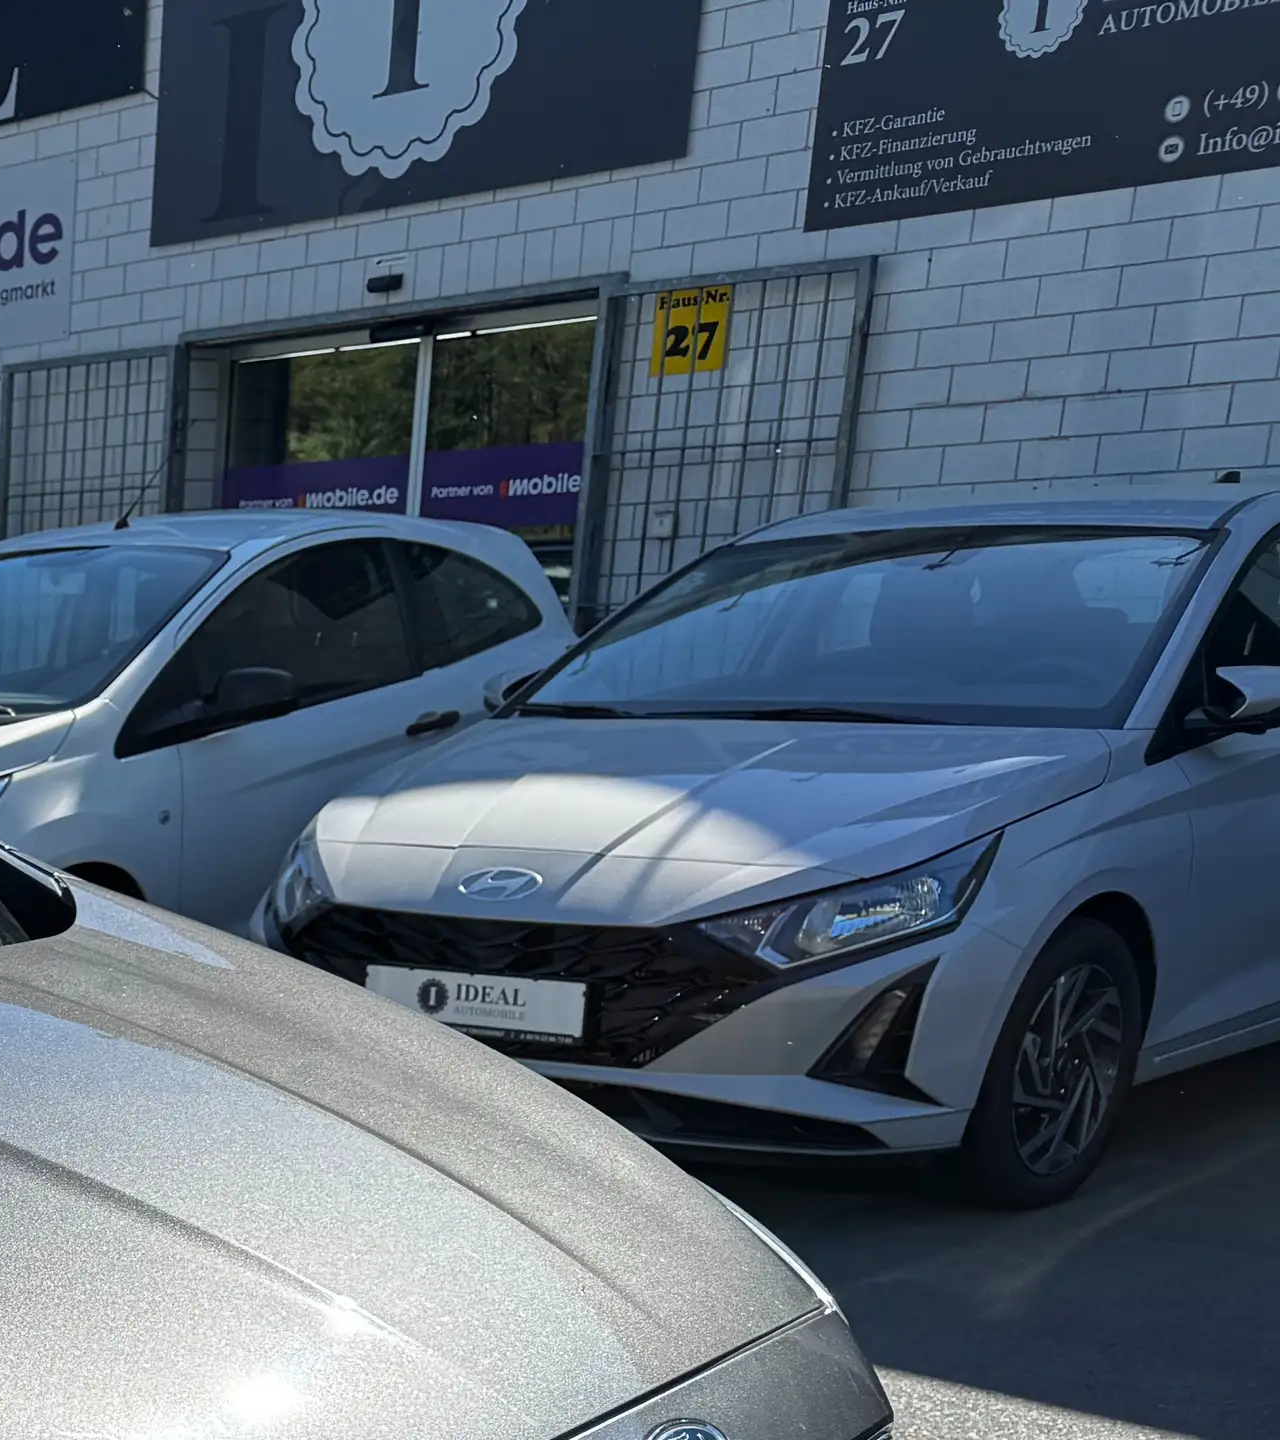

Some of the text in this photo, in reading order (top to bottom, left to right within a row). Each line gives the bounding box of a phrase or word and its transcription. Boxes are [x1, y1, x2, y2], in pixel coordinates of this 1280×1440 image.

[1098, 0, 1280, 35] AUTOMOB
[840, 9, 906, 66] 27
[1203, 81, 1269, 118] (+49)
[842, 107, 945, 137] KFZ-Garantie
[837, 135, 1091, 185] Vermittlung von Gebrauchtwagen
[840, 129, 977, 161] KFZ-Finanzierung
[834, 170, 993, 208] KFZ-Ankauf/Verkauf
[665, 321, 719, 360] 27
[306, 485, 399, 508] mobile.de
[431, 485, 470, 499] Partner
[472, 484, 494, 497] von
[455, 983, 527, 1007] IDEAL
[453, 1005, 527, 1021] AUTOMOBILE
